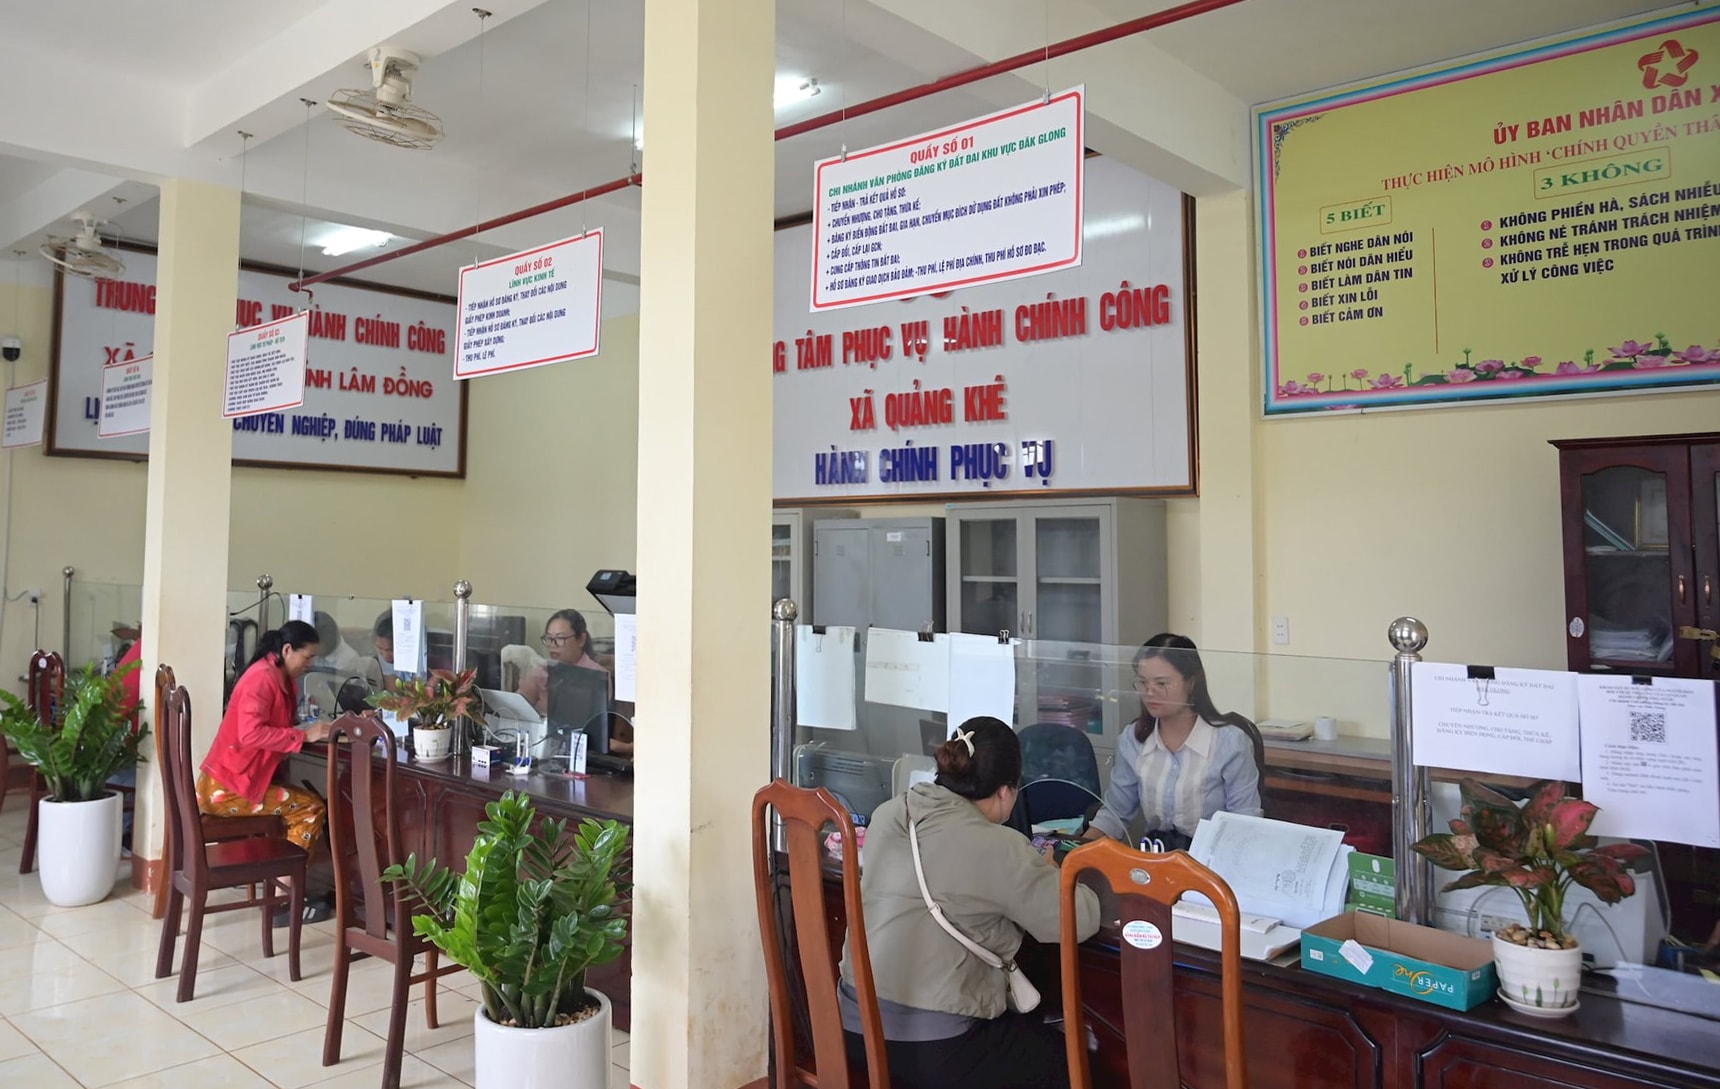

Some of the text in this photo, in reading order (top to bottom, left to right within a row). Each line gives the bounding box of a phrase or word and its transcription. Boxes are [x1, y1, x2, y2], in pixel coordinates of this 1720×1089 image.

[1493, 122, 1520, 144] ỦY
[1527, 114, 1572, 138] BAN
[1580, 100, 1644, 128] NHÂN
[1652, 89, 1702, 114] DÂN
[943, 136, 957, 154] SỐ
[961, 136, 973, 150] 01
[1381, 173, 1422, 190] THỰC
[1427, 164, 1464, 182] HIỆN
[1469, 156, 1495, 176] MÔ
[1500, 151, 1541, 170] HÌNH
[1613, 122, 1677, 150] QUYỀN
[829, 186, 840, 197] CHI
[842, 180, 867, 194] NHÁNH
[870, 176, 884, 188] VĂN
[886, 170, 912, 184] PHÒNG
[914, 164, 934, 177] ĐĂNG
[949, 155, 964, 168] ĐẤT
[966, 152, 979, 164] ĐAI
[982, 147, 998, 160] KHU
[1000, 142, 1016, 155] VỰC
[1038, 127, 1065, 144] GLONG
[1540, 159, 1664, 190] 3 KHÔNG
[869, 192, 878, 204] KẾT
[879, 188, 888, 202] QUẢ
[993, 196, 1003, 209] ĐẤT
[1038, 186, 1048, 198] XIN
[1500, 211, 1546, 228] KHÔNG
[1628, 192, 1670, 209] SÁCH
[873, 208, 883, 219] CHO
[1326, 200, 1386, 224] 5 BIẾT
[1310, 230, 1414, 257] BIẾT NGHE DÂN NÓI
[1500, 230, 1545, 247] KHÔNG
[1550, 224, 1566, 240] NÉ
[1572, 218, 1618, 236] TRÁNH
[1622, 212, 1670, 229] TRÁCH
[1500, 222, 1720, 266] KHÔNG TRỄ HẸN TRONG QUÁ TRÌN
[533, 258, 542, 270] SỐ
[544, 256, 552, 267] 02
[985, 252, 995, 263] THU
[996, 248, 1006, 261] PHÍ
[1311, 246, 1413, 274] BIẾT NÓI DÂN HIỂU
[1312, 268, 1413, 290] BIẾT LÀM DÂN TIN
[1501, 257, 1614, 284] XỬ LÝ CÔNG VIỆC
[1312, 286, 1378, 308] BIẾT XIN LỖI
[94, 277, 157, 315] TRUNG
[355, 314, 400, 348] CHÍNH
[408, 320, 446, 354] CÔNG
[795, 329, 832, 370] TÂM
[842, 326, 891, 368] PHỤC
[902, 320, 930, 362] VỤ
[943, 306, 1004, 352] HÀNH
[1015, 292, 1086, 342] CHÍNH
[1099, 280, 1170, 332] CÔNG
[1312, 306, 1383, 325] BIẾT CẢM ƠN
[340, 366, 376, 393] LÂM
[384, 366, 434, 398] ĐỒNG
[849, 374, 1008, 431] XÃ QUẢNG KHÊ
[292, 412, 338, 442] NGHIỆP,
[344, 416, 376, 441] ĐÚNG
[381, 419, 412, 444] PHÁP
[417, 422, 443, 450] LUẬT
[815, 438, 1056, 488] HÀNH CHÍNH PHỤC VỤ
